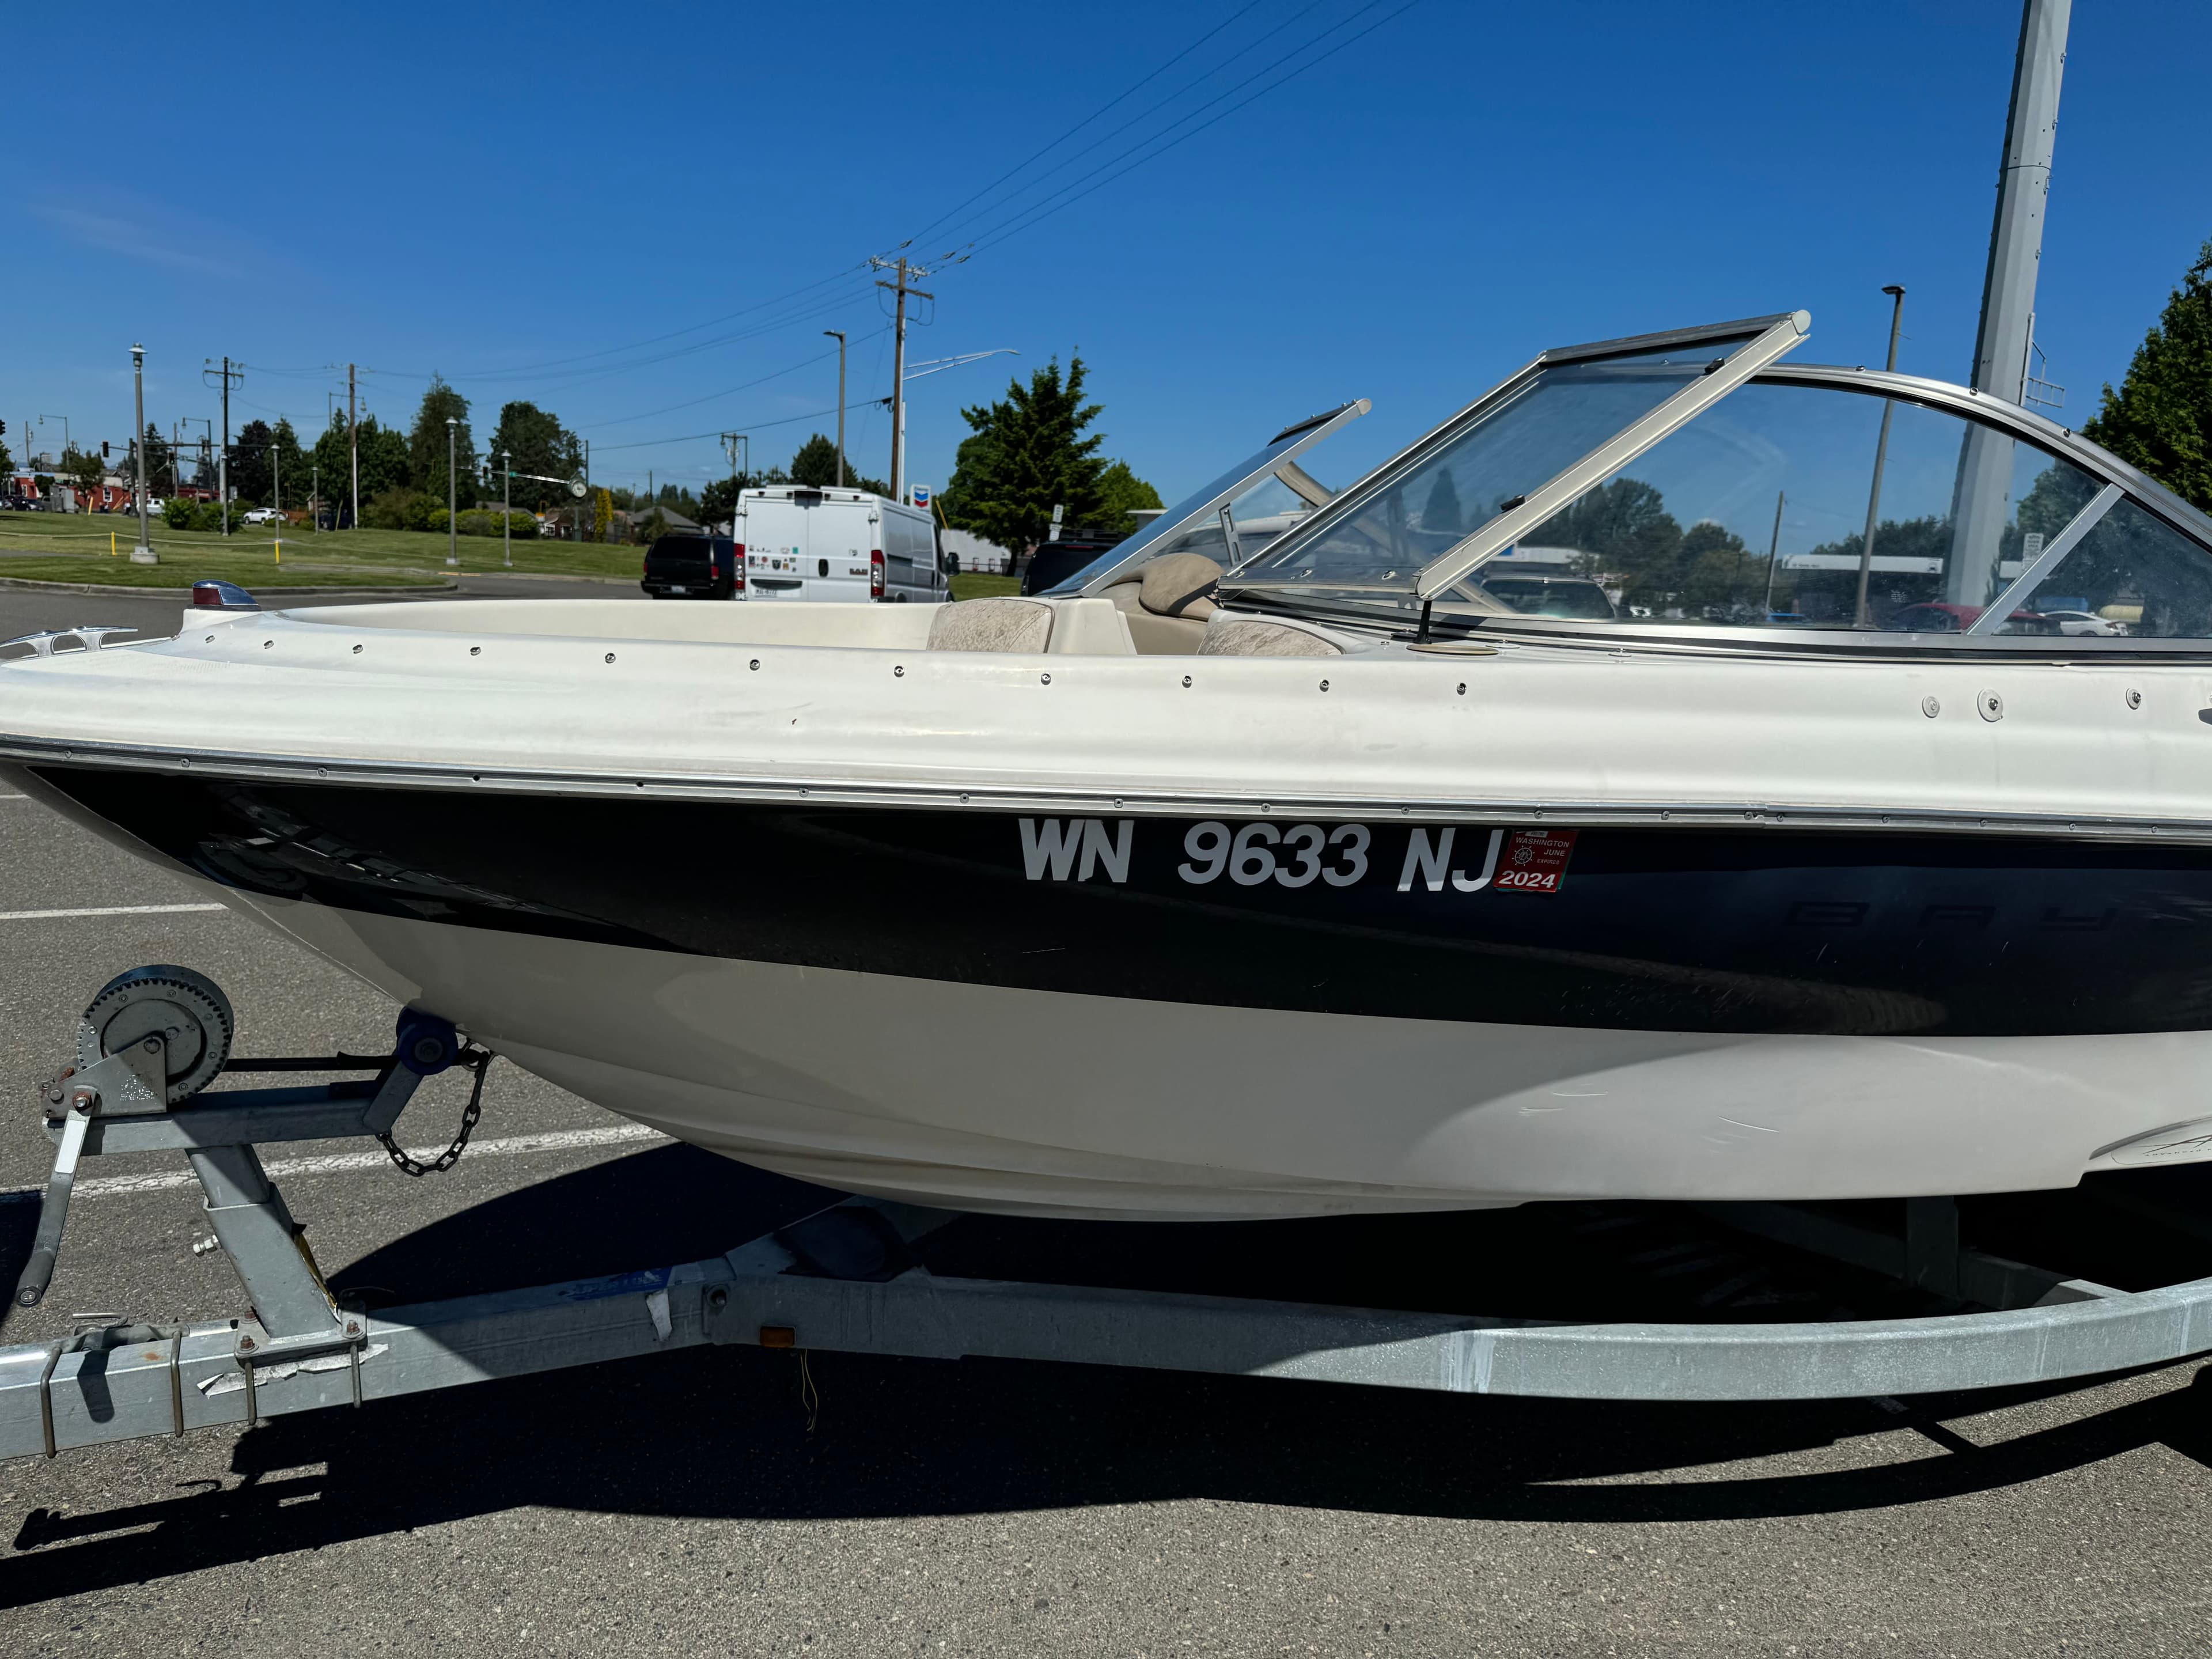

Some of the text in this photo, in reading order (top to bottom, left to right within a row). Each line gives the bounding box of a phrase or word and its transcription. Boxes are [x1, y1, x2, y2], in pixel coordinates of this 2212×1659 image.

[1516, 836, 1570, 848] WASHINGTON
[1018, 818, 1505, 892] WN 9633 NJ
[1543, 849, 1566, 857] JUNE
[1498, 870, 1556, 888] 2024
